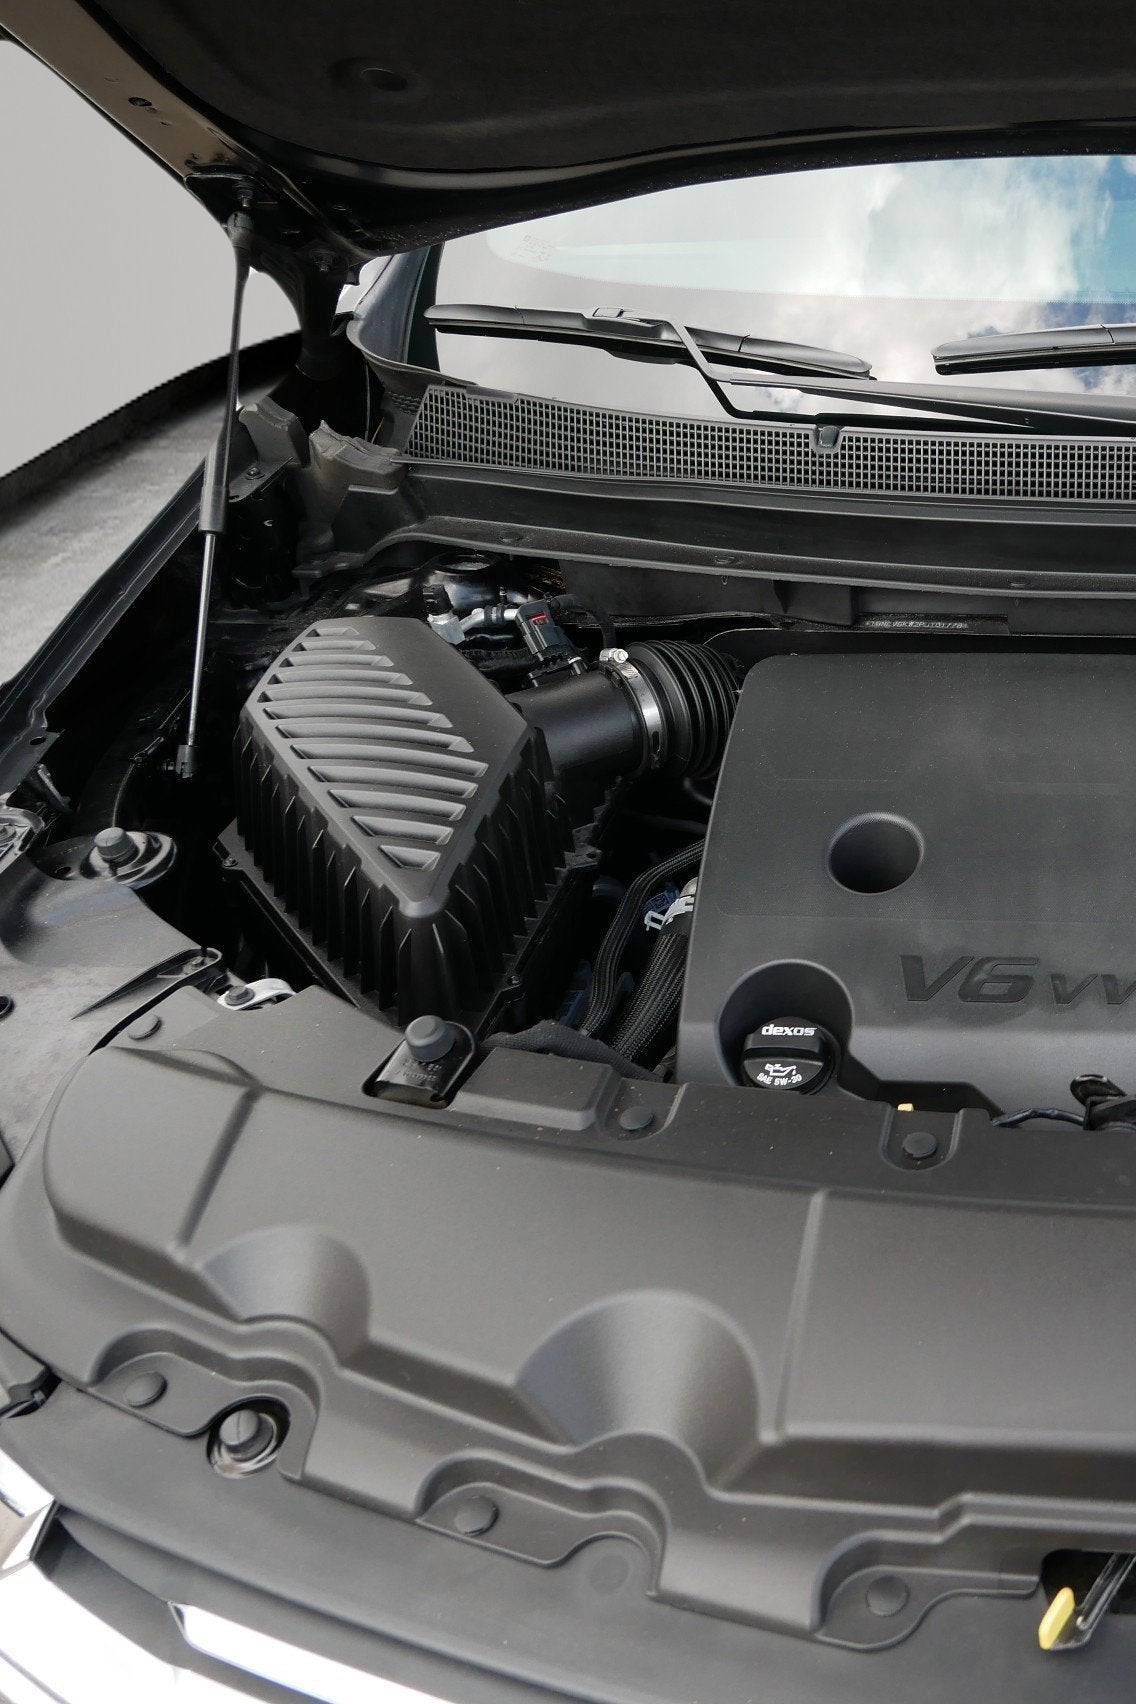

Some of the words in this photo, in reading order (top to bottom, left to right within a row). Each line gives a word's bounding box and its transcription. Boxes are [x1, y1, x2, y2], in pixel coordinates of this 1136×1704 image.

[899, 953, 1039, 1003] V6
[761, 1023, 817, 1036] dexos
[756, 1072, 773, 1085] SAE
